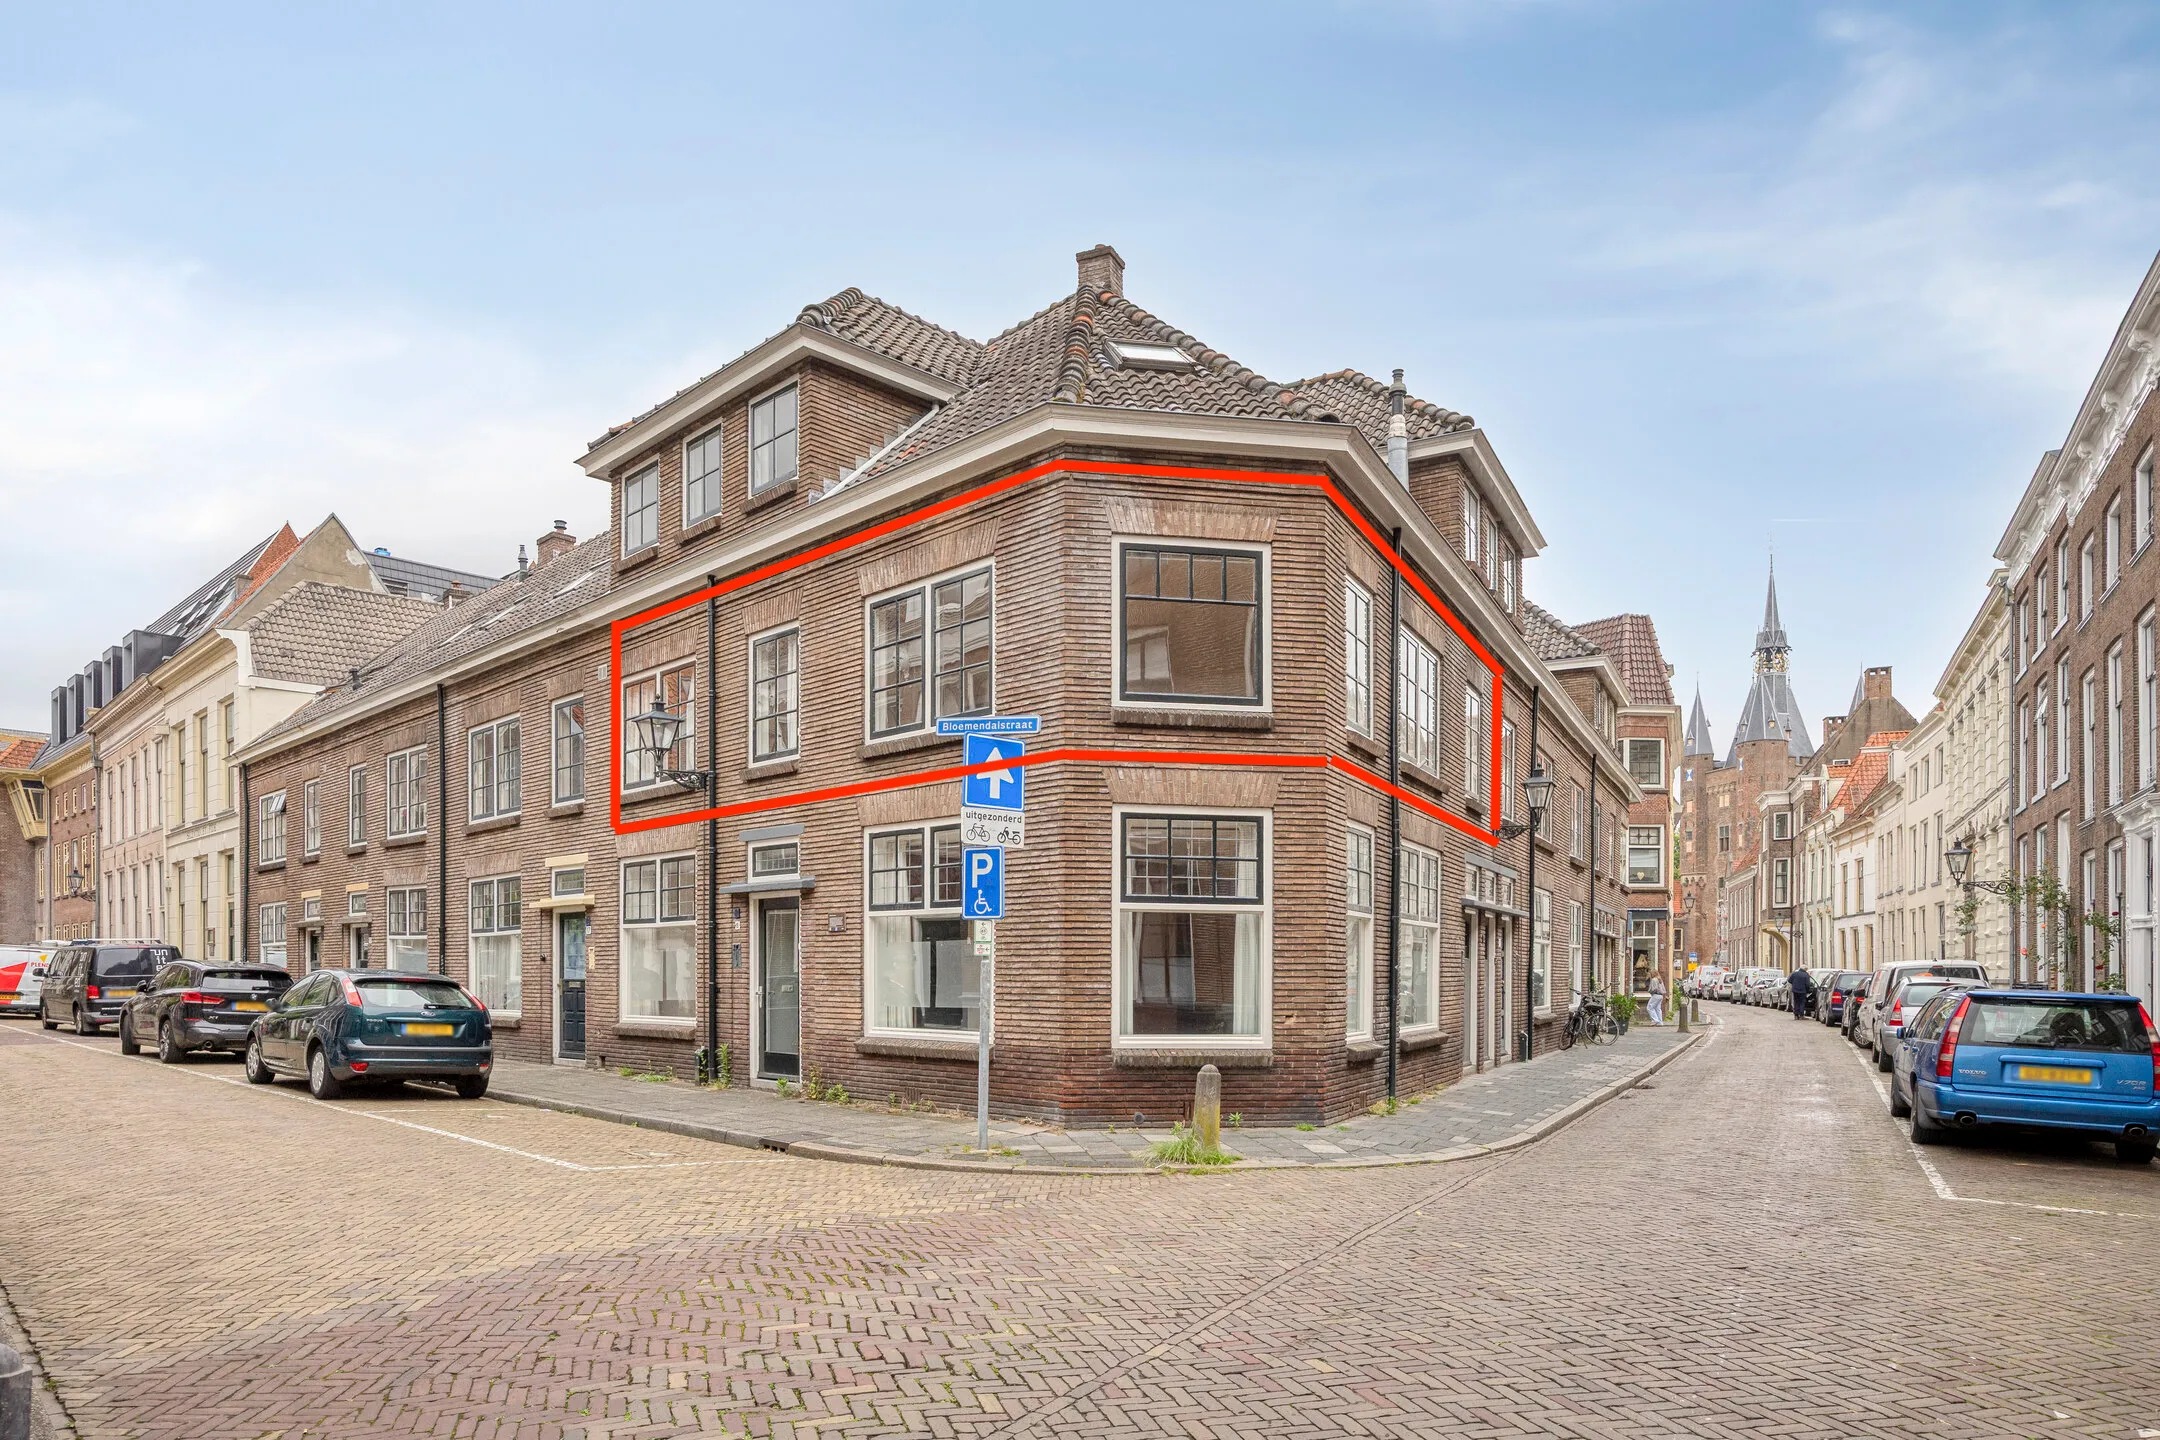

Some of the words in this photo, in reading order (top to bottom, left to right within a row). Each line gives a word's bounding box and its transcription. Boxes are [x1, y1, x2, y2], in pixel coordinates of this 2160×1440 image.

[942, 721, 1033, 731] Bloemendalstraat
[965, 811, 1022, 823] uitgezonderd
[971, 853, 993, 888] P
